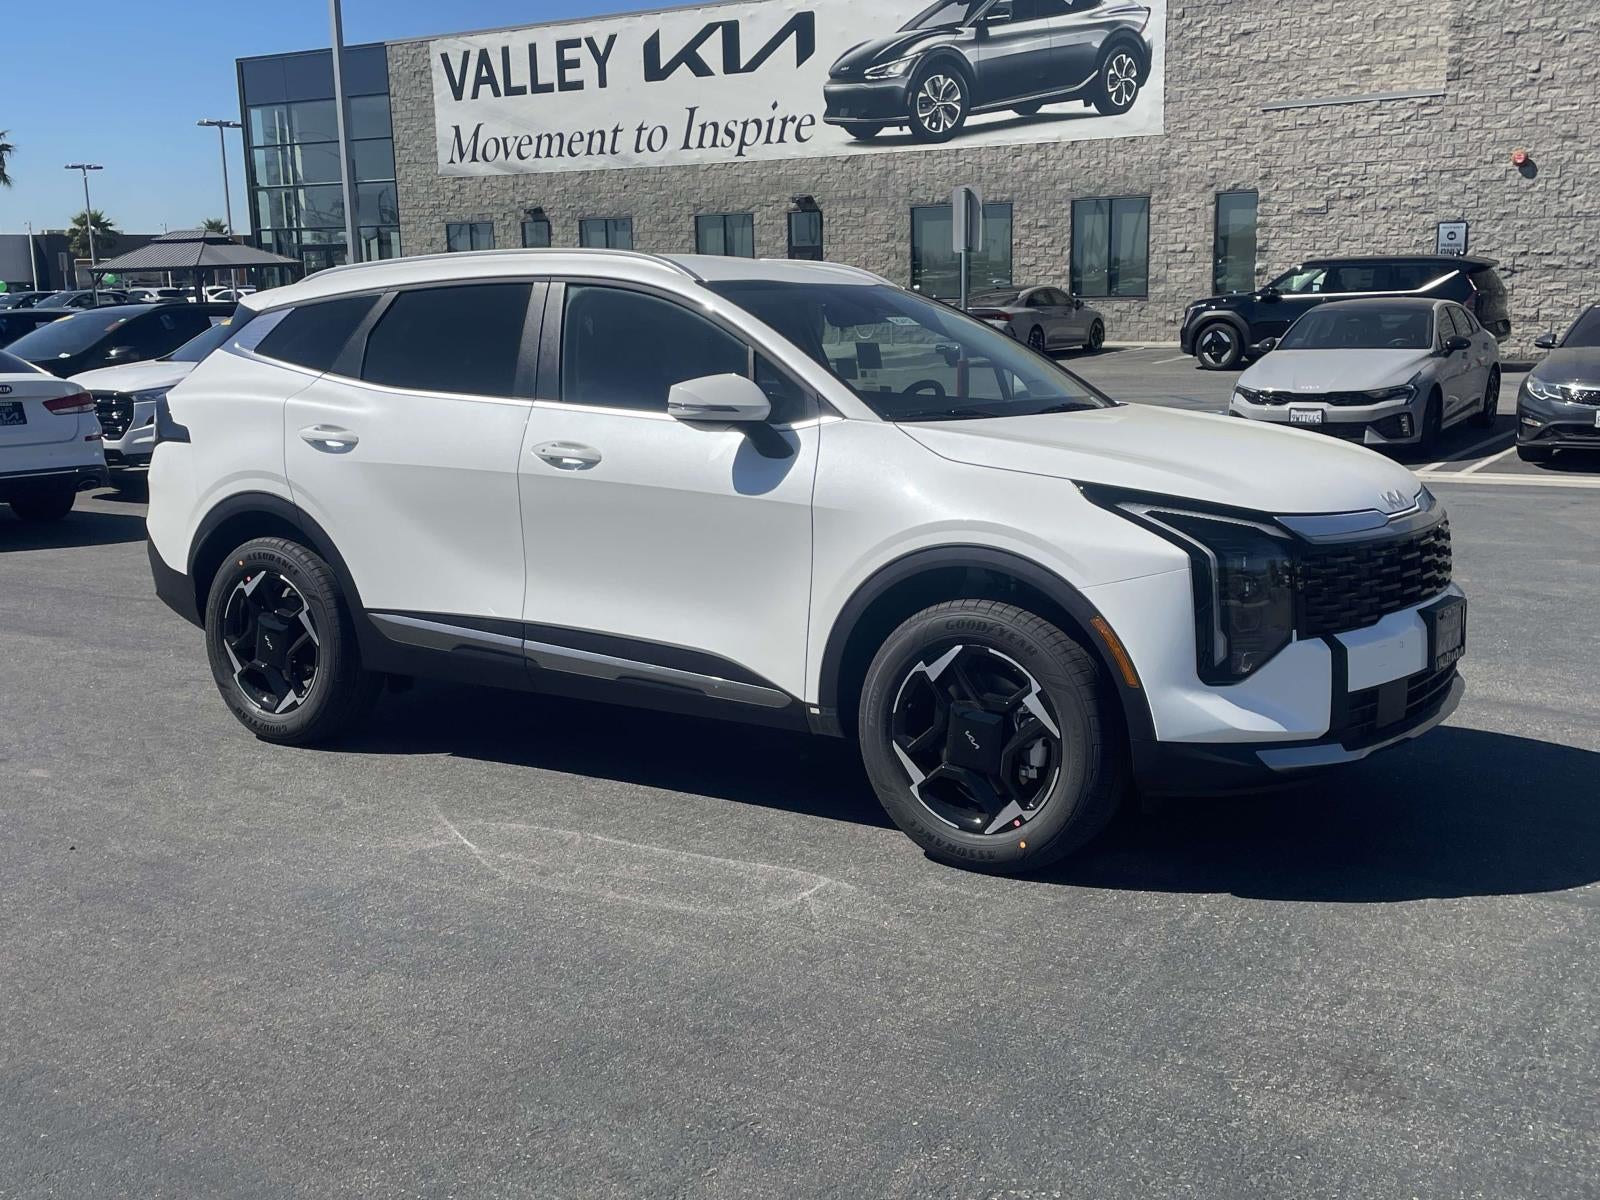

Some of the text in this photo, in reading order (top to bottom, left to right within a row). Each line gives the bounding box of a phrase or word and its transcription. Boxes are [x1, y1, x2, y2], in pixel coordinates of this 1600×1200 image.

[440, 33, 617, 100] VALLEY
[447, 101, 816, 164] Movement to Inspire
[247, 552, 301, 576] ASSURANCE
[944, 619, 1038, 656] GOODYEAR
